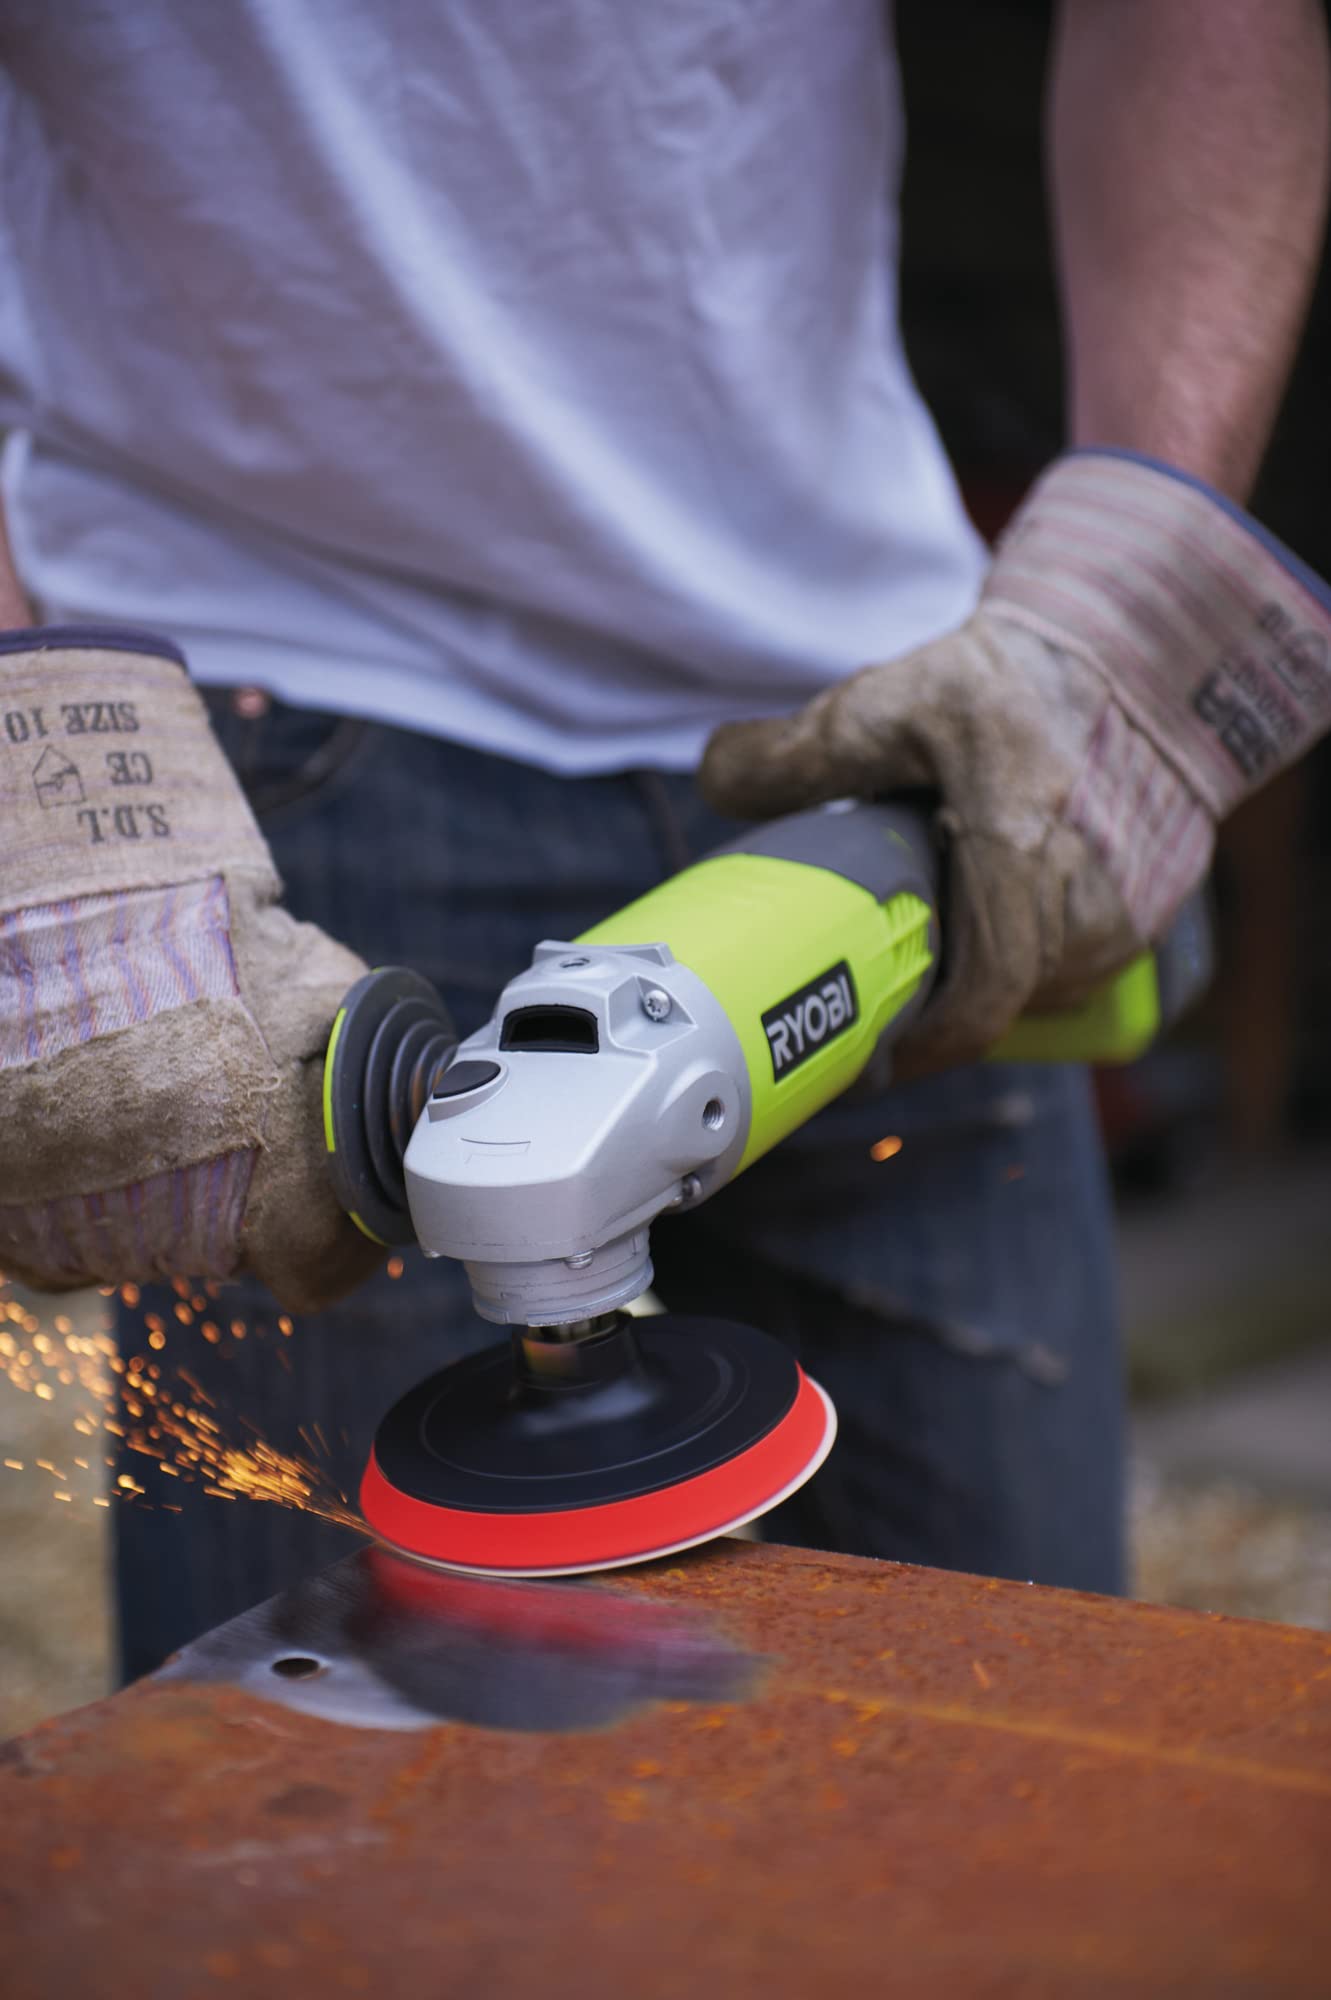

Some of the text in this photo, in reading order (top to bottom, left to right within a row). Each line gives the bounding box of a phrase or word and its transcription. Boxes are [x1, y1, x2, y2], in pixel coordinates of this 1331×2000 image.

[4, 702, 140, 744] SIZE 10
[106, 752, 153, 786] CE
[766, 973, 854, 1069] RYOBI
